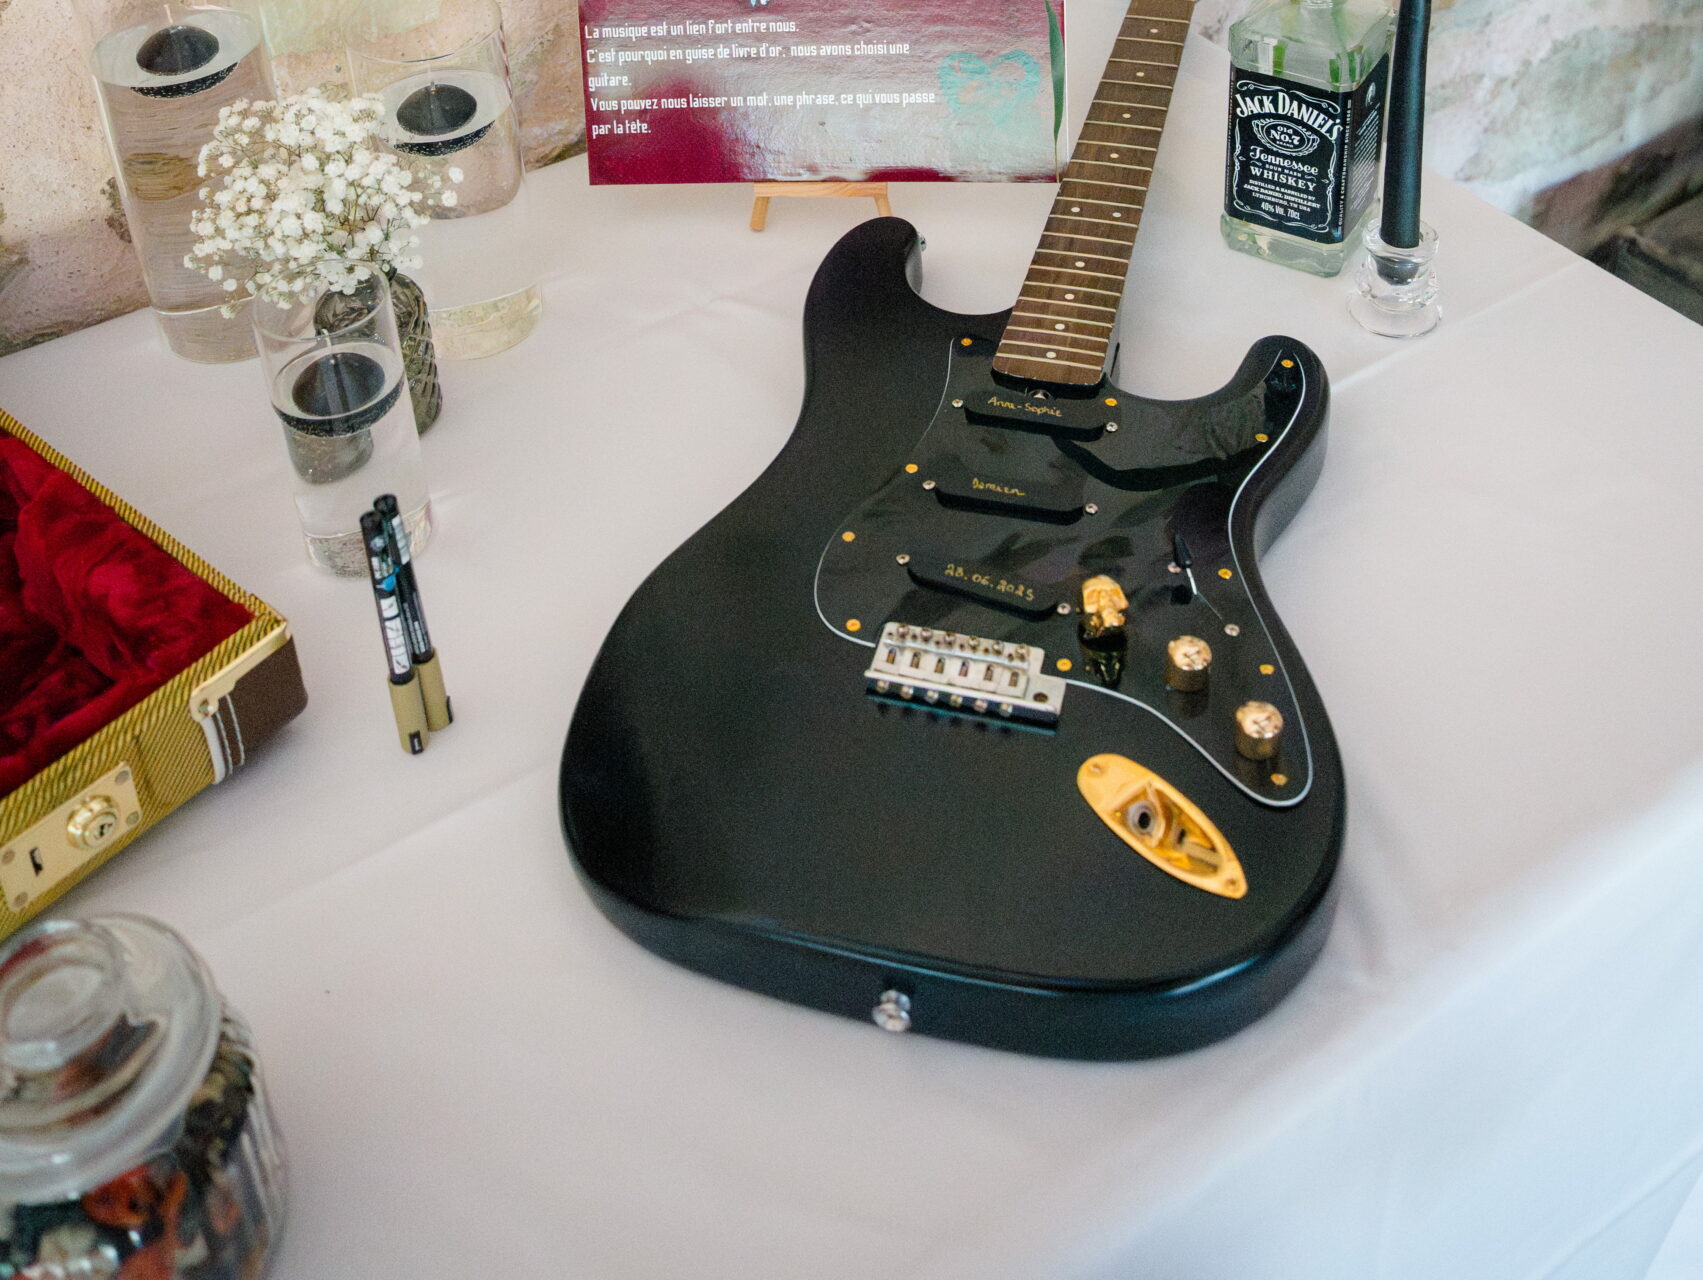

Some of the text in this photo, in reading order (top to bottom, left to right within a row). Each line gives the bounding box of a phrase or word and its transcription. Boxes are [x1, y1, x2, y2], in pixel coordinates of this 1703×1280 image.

[584, 19, 799, 41] La musique est un lien fort entre nous.
[586, 48, 617, 63] C'est
[618, 46, 667, 66] pourquoi
[669, 49, 683, 60] en
[685, 46, 715, 63] guise
[717, 44, 730, 58] de
[732, 43, 757, 58] livre
[790, 44, 817, 57] nous
[819, 44, 851, 56] avons
[854, 40, 887, 55] choisi
[889, 43, 910, 54] une
[588, 72, 632, 92] guitare.
[590, 97, 618, 111] Vous
[620, 98, 659, 114] pouvez
[661, 97, 688, 109] nous
[689, 93, 728, 108] laisser
[730, 96, 744, 107] un
[774, 94, 794, 106] une
[840, 93, 854, 105] ce
[856, 89, 872, 108] qui
[875, 92, 900, 104] vous
[902, 91, 936, 107] passe
[1234, 91, 1344, 141] JACK DANIEL'S
[591, 119, 652, 139] par la tête.
[1269, 129, 1301, 145] No.7
[1249, 145, 1319, 175] Tennessee
[1249, 165, 1317, 191] WHISKEY
[1265, 164, 1302, 178] SOUR MASH
[1243, 183, 1260, 192] JACK
[1249, 179, 1275, 190] DISTILLED
[1260, 201, 1275, 213] 40%
